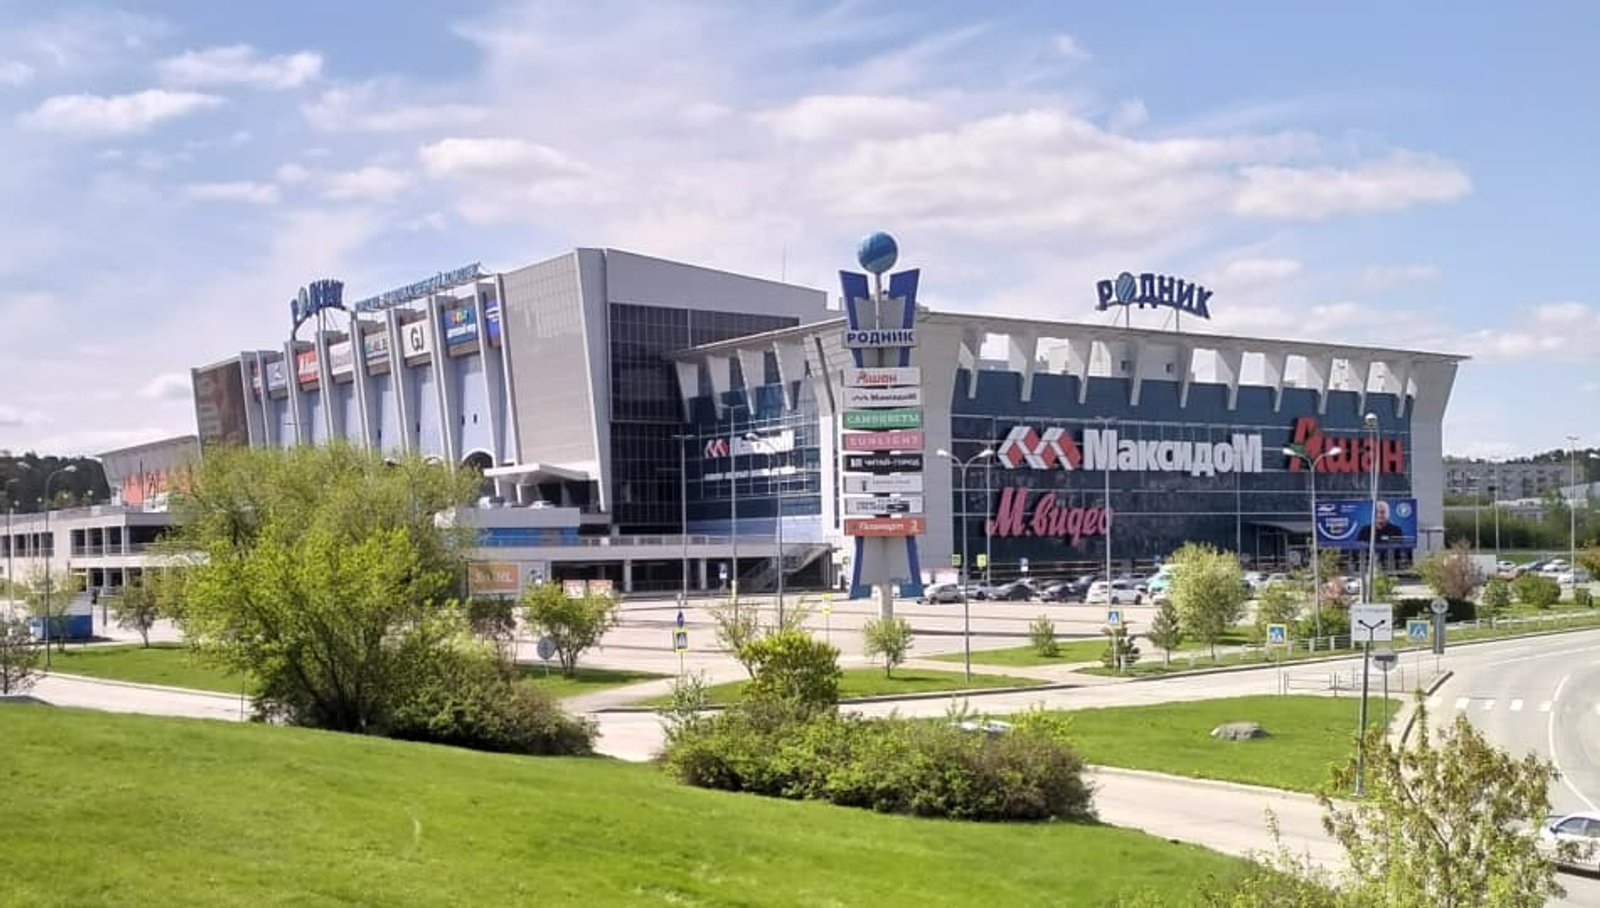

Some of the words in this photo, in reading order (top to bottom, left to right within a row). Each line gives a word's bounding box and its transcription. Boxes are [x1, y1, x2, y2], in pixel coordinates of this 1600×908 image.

[1095, 271, 1213, 320] РОДНИК
[846, 331, 914, 345] РОДНИК
[856, 370, 898, 384] Ашан
[849, 435, 919, 447] SUNLIGHT
[1083, 427, 1264, 477] МаксидоМ
[1288, 416, 1404, 474] Ашан
[985, 487, 1114, 544] М.видео
